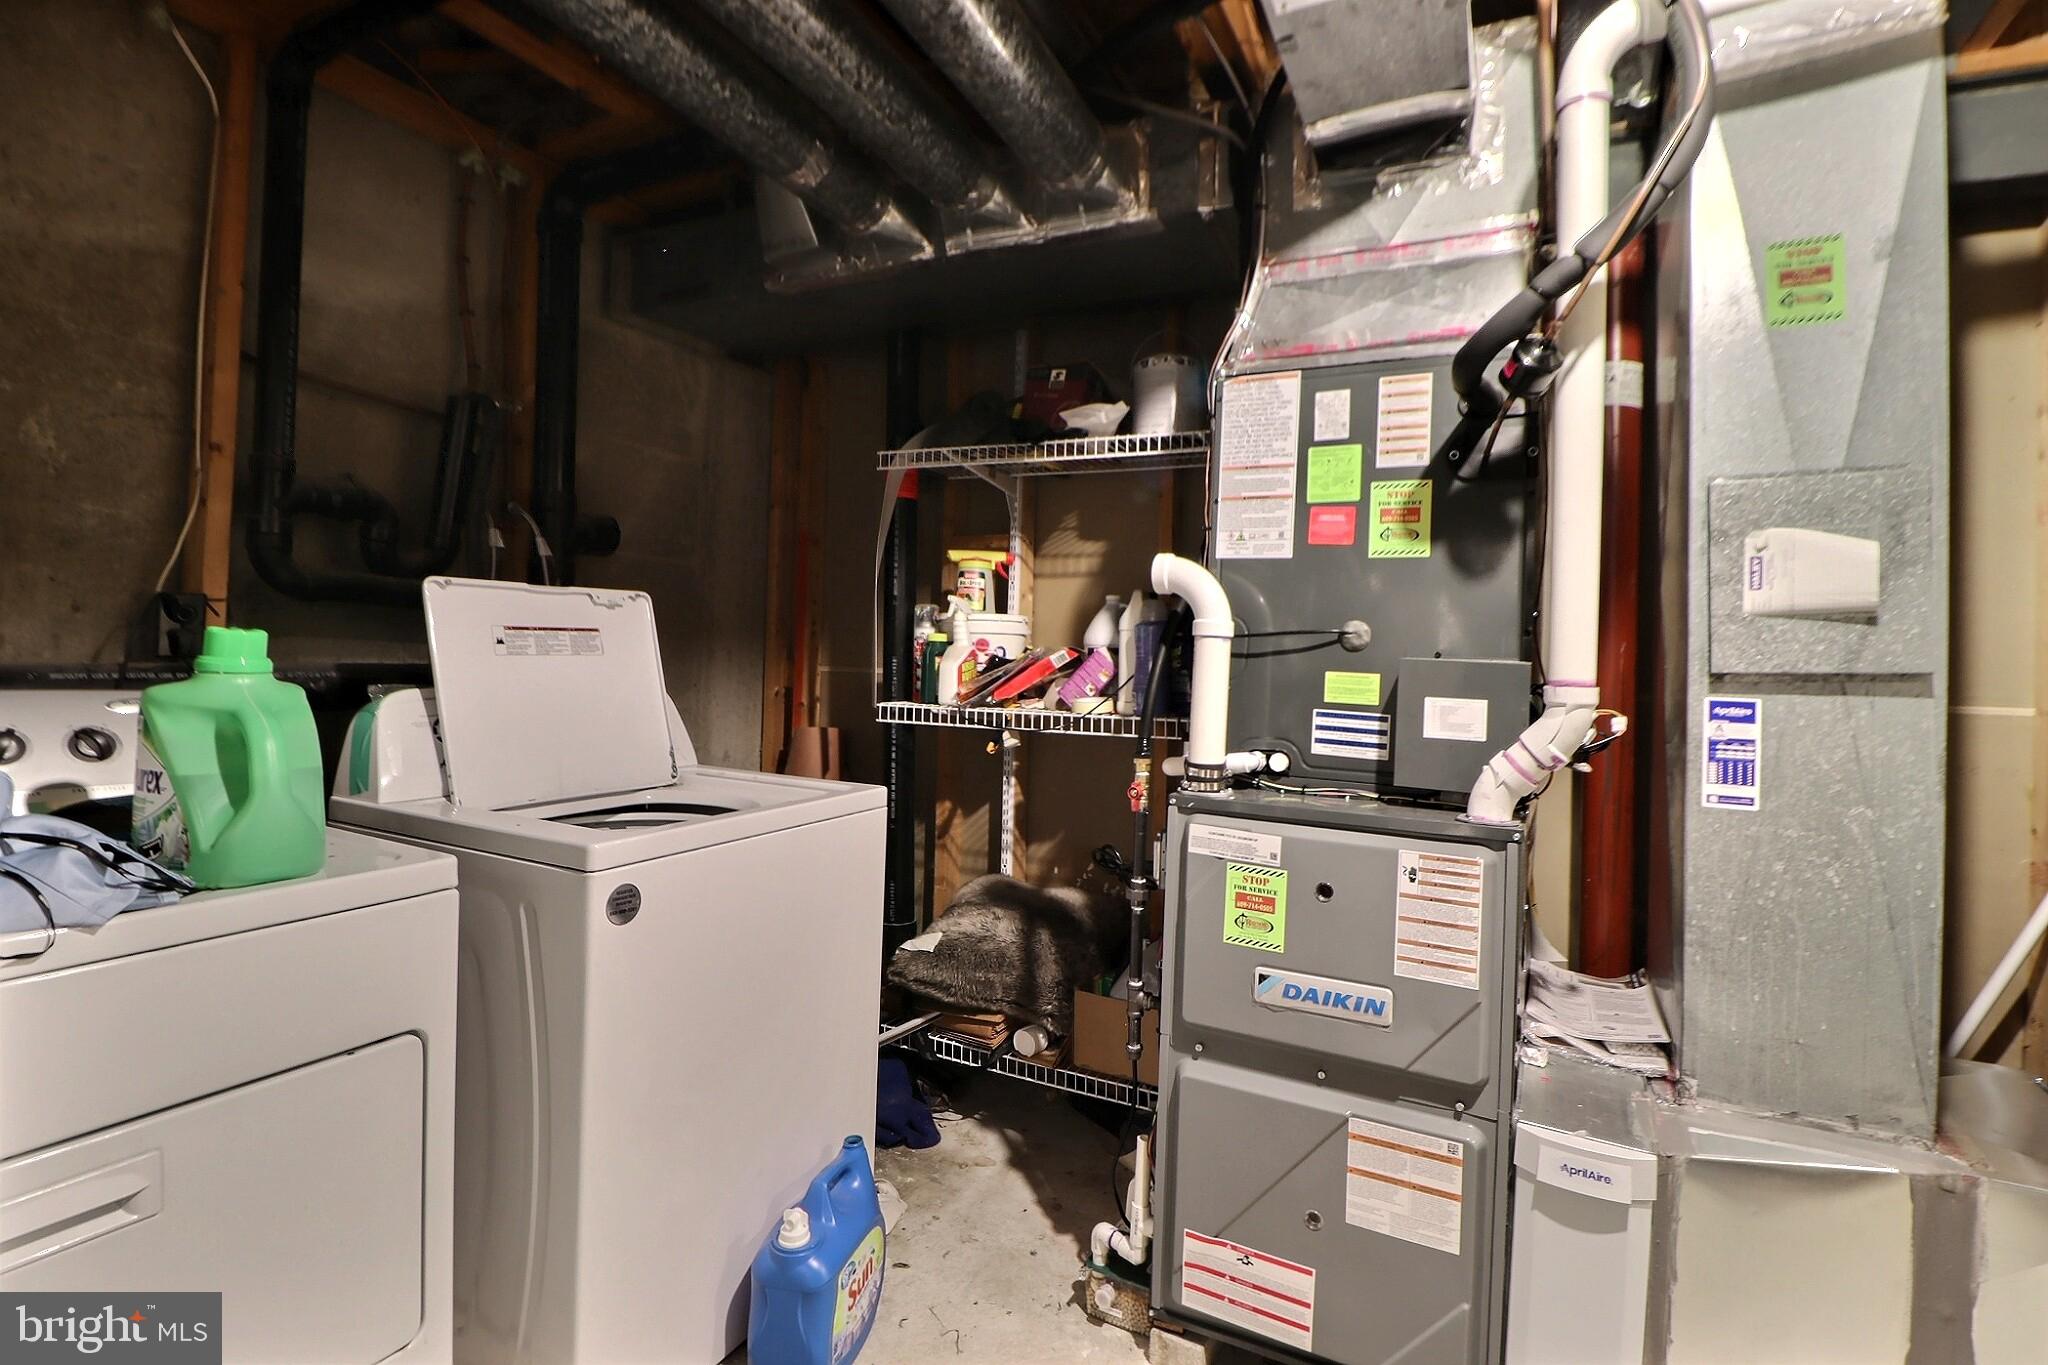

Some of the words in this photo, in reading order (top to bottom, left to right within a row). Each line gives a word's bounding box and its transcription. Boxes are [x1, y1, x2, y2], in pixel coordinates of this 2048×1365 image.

[1387, 490, 1414, 498] STOP
[1242, 875, 1270, 886] STOP
[1249, 886, 1278, 896] SERVICE
[1282, 983, 1386, 1016] DAIKIN
[1560, 1164, 1611, 1184] AprilAire
[847, 1256, 874, 1312] Sun
